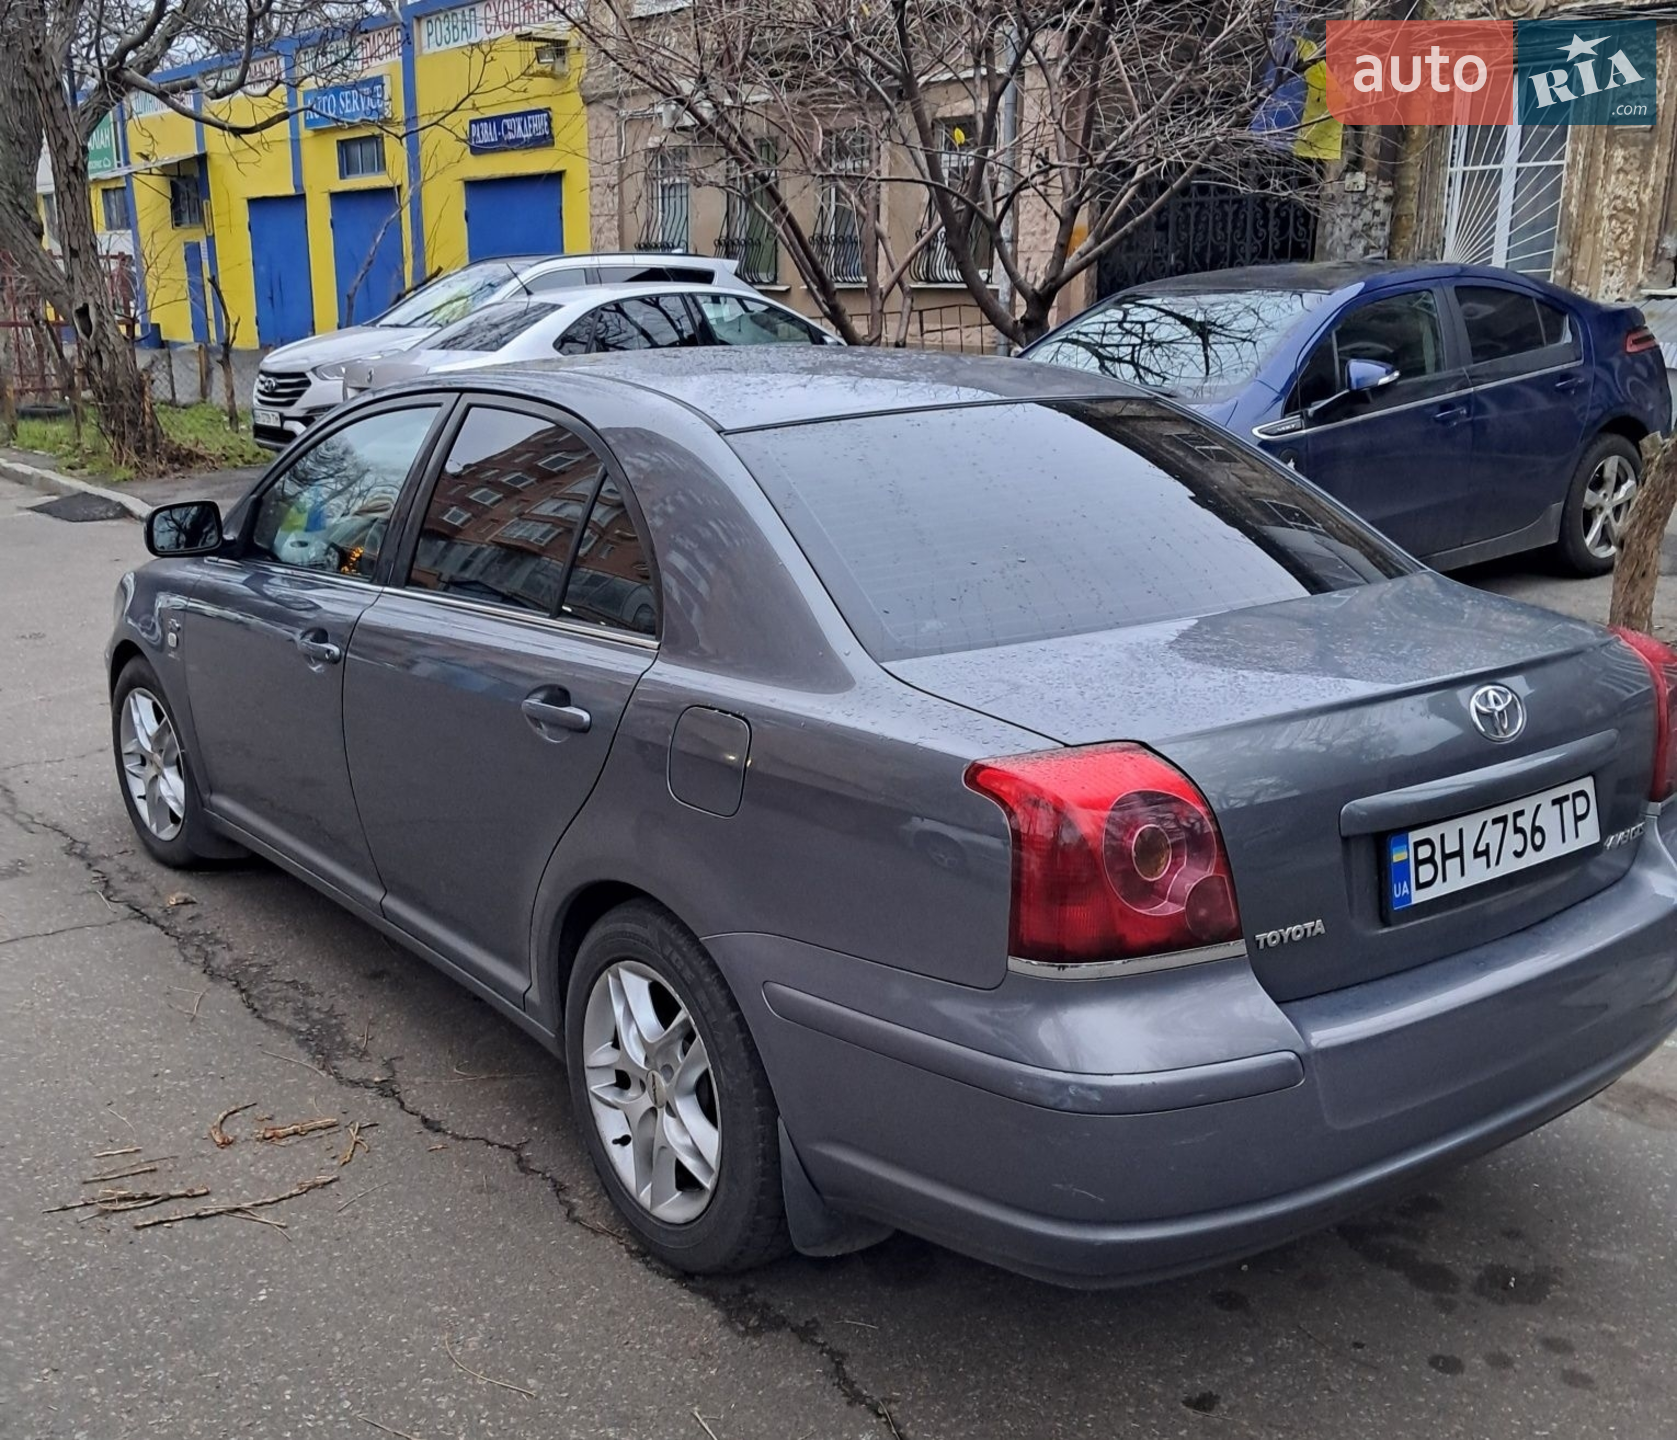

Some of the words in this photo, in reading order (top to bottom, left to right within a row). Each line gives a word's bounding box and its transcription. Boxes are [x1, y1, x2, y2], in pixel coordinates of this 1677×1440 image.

[339, 85, 383, 115] SERVICE
[1413, 827, 1466, 891] BH
[1473, 803, 1547, 870] 4756
[1551, 789, 1590, 845] TP
[1393, 880, 1410, 898] UA
[1255, 918, 1326, 950] TOYOTA
